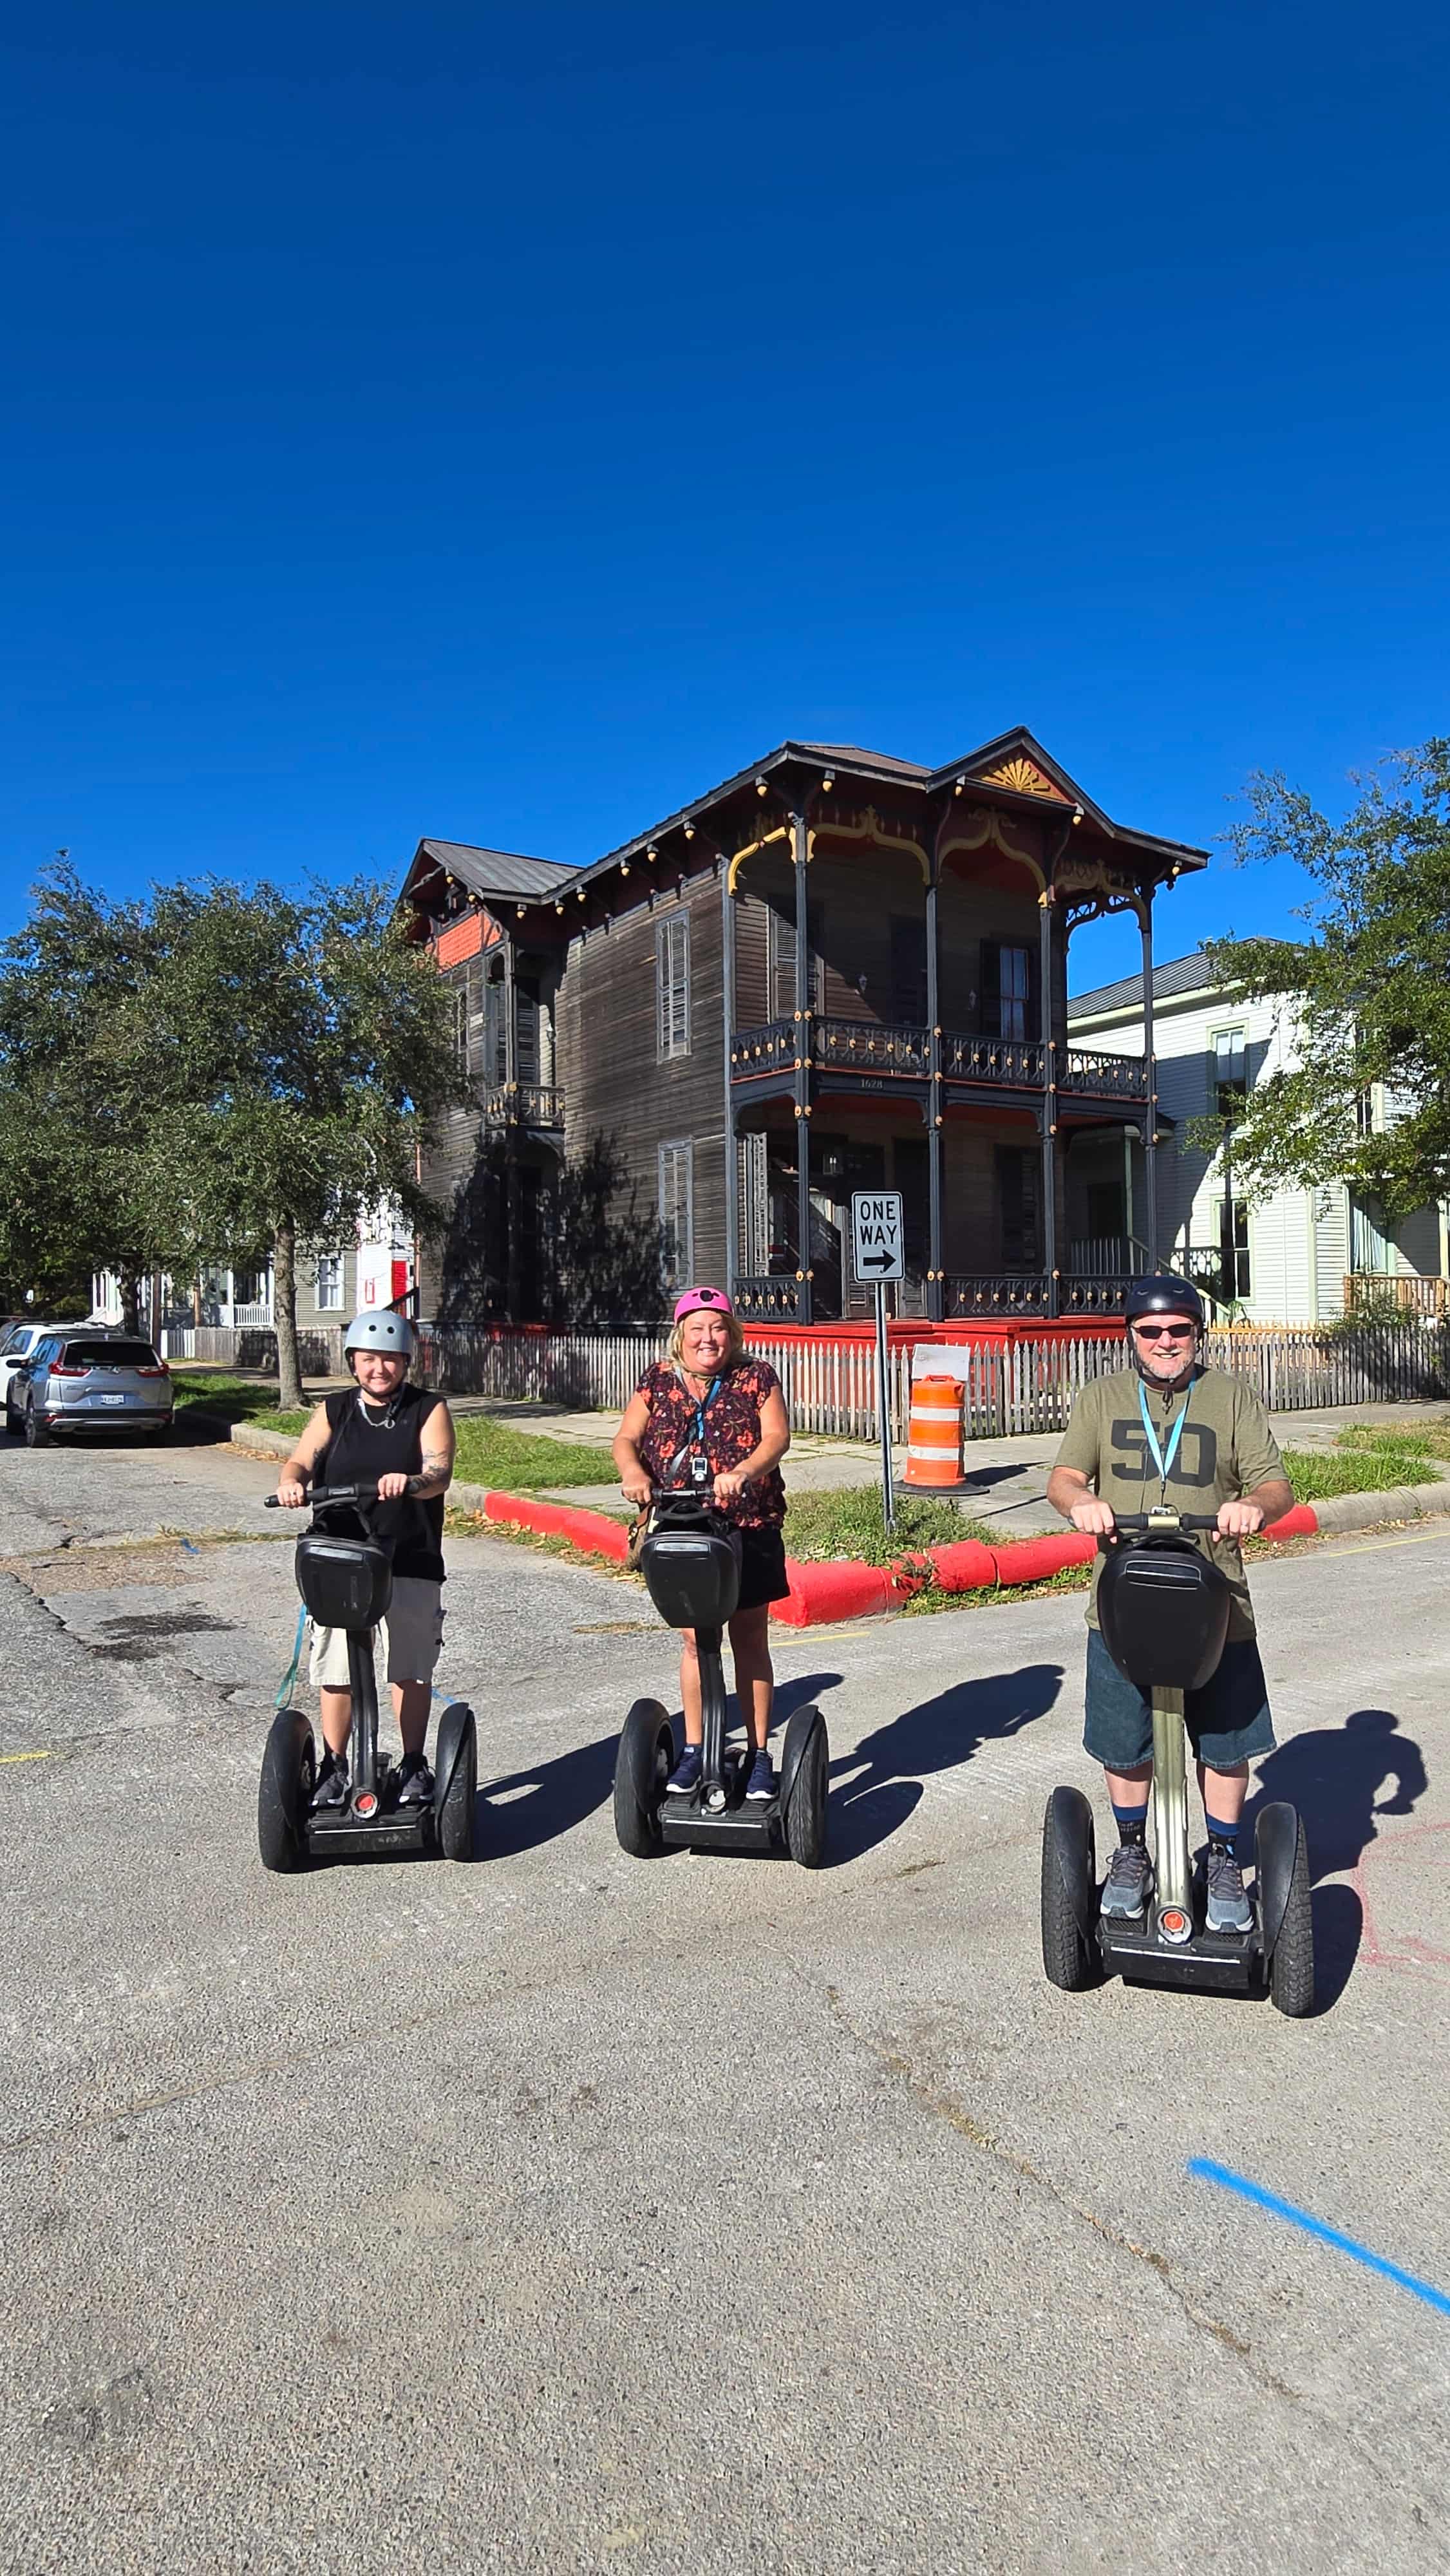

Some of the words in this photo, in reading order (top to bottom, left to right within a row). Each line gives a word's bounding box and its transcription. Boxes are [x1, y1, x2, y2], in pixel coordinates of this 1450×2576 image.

[860, 1200, 896, 1220] ONE
[860, 1224, 897, 1245] WAY
[1111, 1419, 1217, 1488] 50
